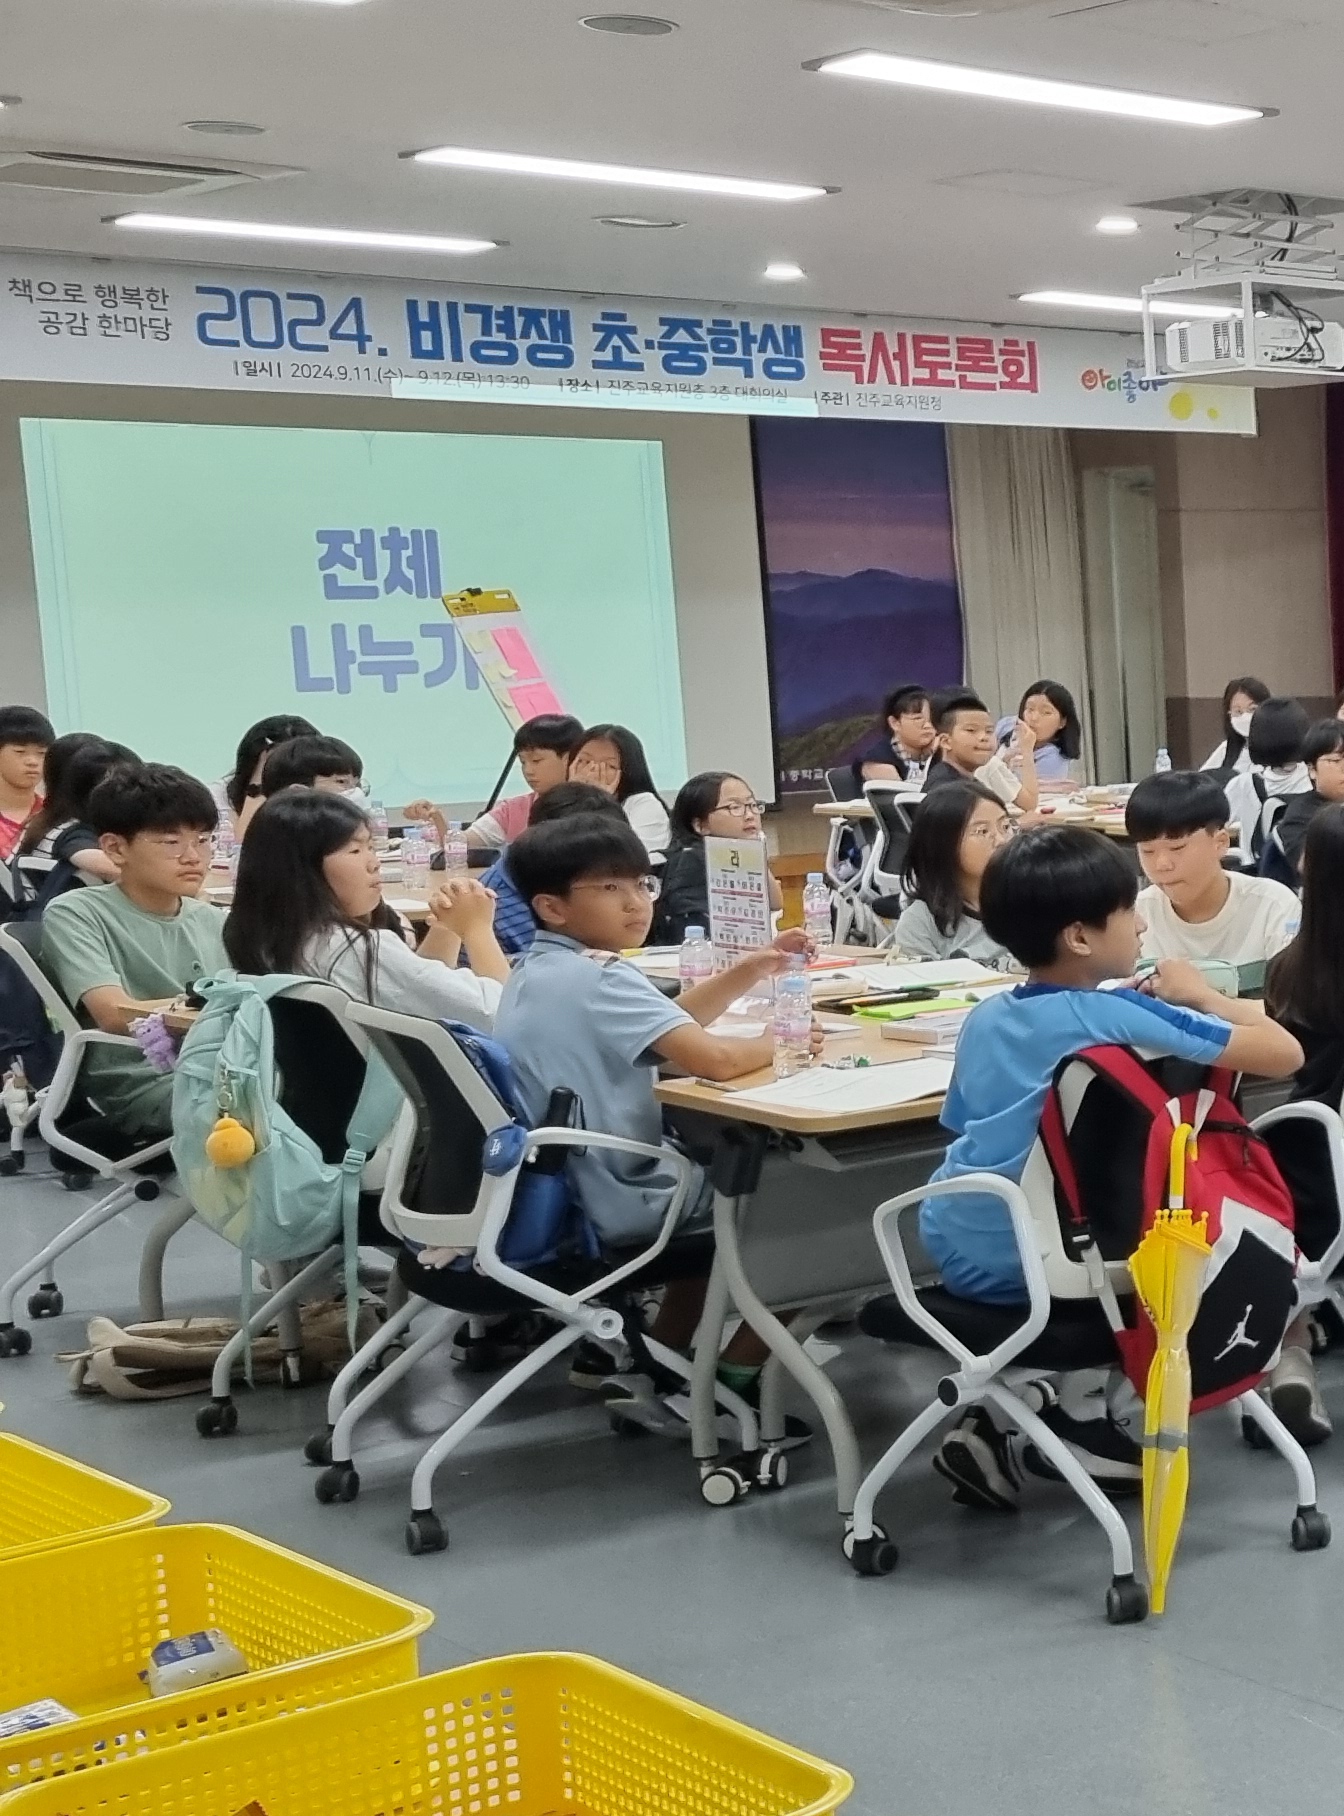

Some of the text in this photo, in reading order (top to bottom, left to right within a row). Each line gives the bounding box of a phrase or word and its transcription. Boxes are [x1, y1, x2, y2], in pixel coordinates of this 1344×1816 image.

[7, 278, 171, 312] 책으로 행복한
[37, 310, 174, 343] 공감 한마당
[194, 285, 390, 358] 2024.
[406, 299, 576, 370] 비경쟁
[818, 327, 1040, 394] 독서토론회
[855, 392, 944, 411] 진주교육지원청
[316, 527, 442, 600] 전체
[291, 623, 480, 695] 나누기
